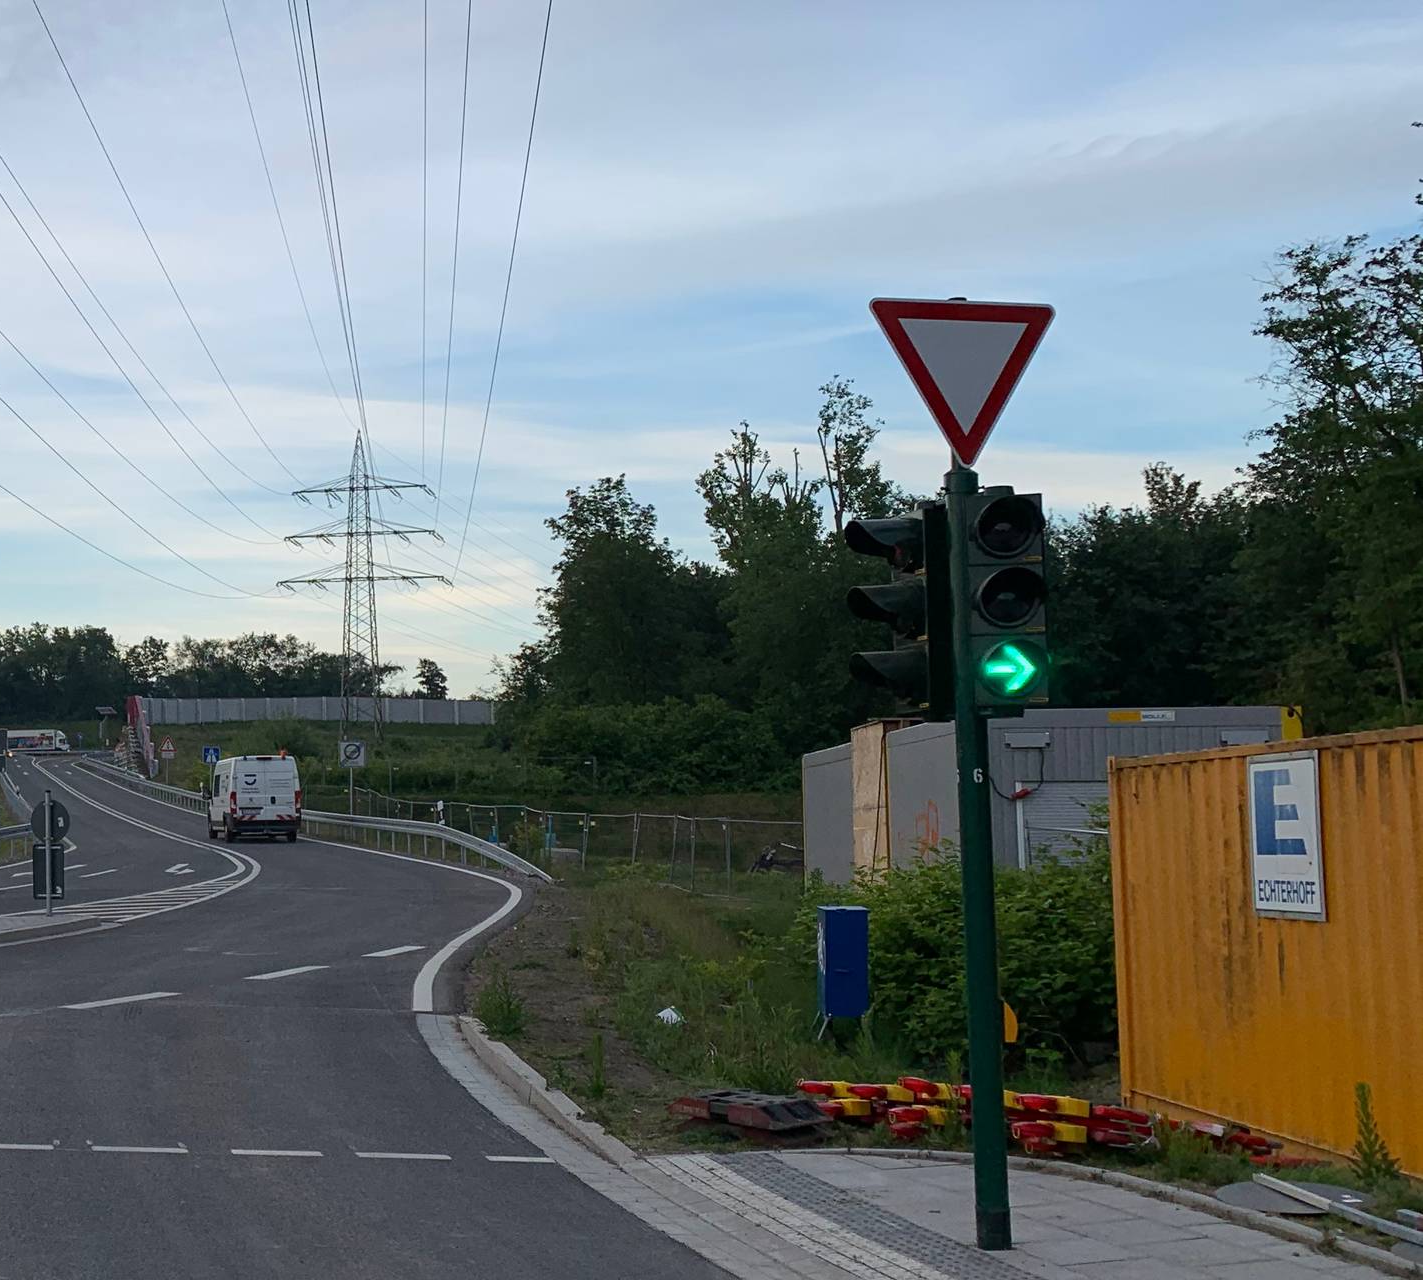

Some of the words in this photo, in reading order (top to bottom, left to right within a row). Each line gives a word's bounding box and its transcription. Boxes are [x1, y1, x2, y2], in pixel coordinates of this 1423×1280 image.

[972, 767, 984, 784] 6
[1253, 769, 1308, 856] E
[1258, 879, 1316, 905] ECHTERHOFF
